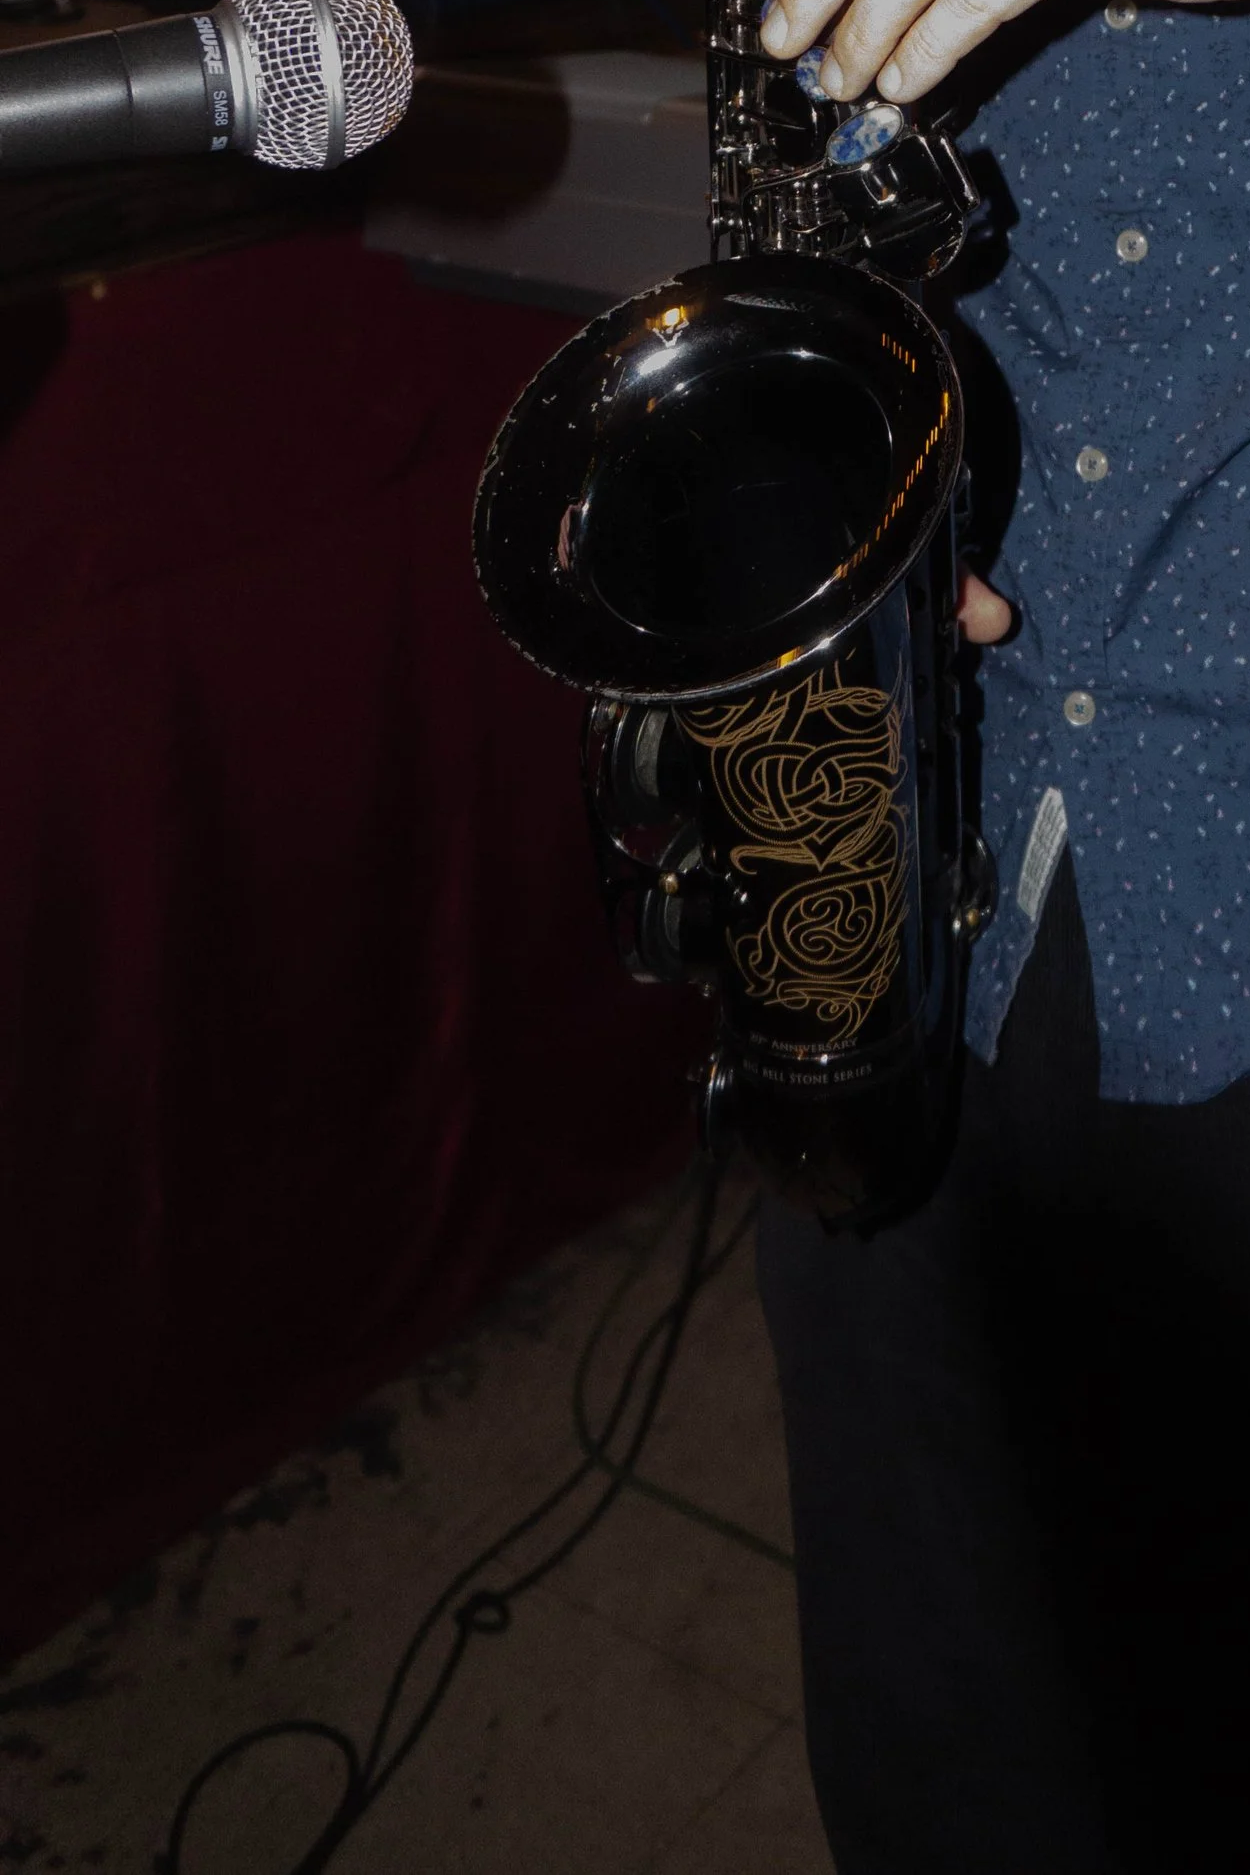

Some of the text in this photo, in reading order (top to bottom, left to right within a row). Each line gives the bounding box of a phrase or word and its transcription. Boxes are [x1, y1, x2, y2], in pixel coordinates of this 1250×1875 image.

[193, 16, 225, 75] SHURE
[212, 90, 230, 127] SM58
[771, 1036, 859, 1054] ANNIVERSARY
[789, 1071, 830, 1086] STONE
[832, 1062, 874, 1083] SERIES
